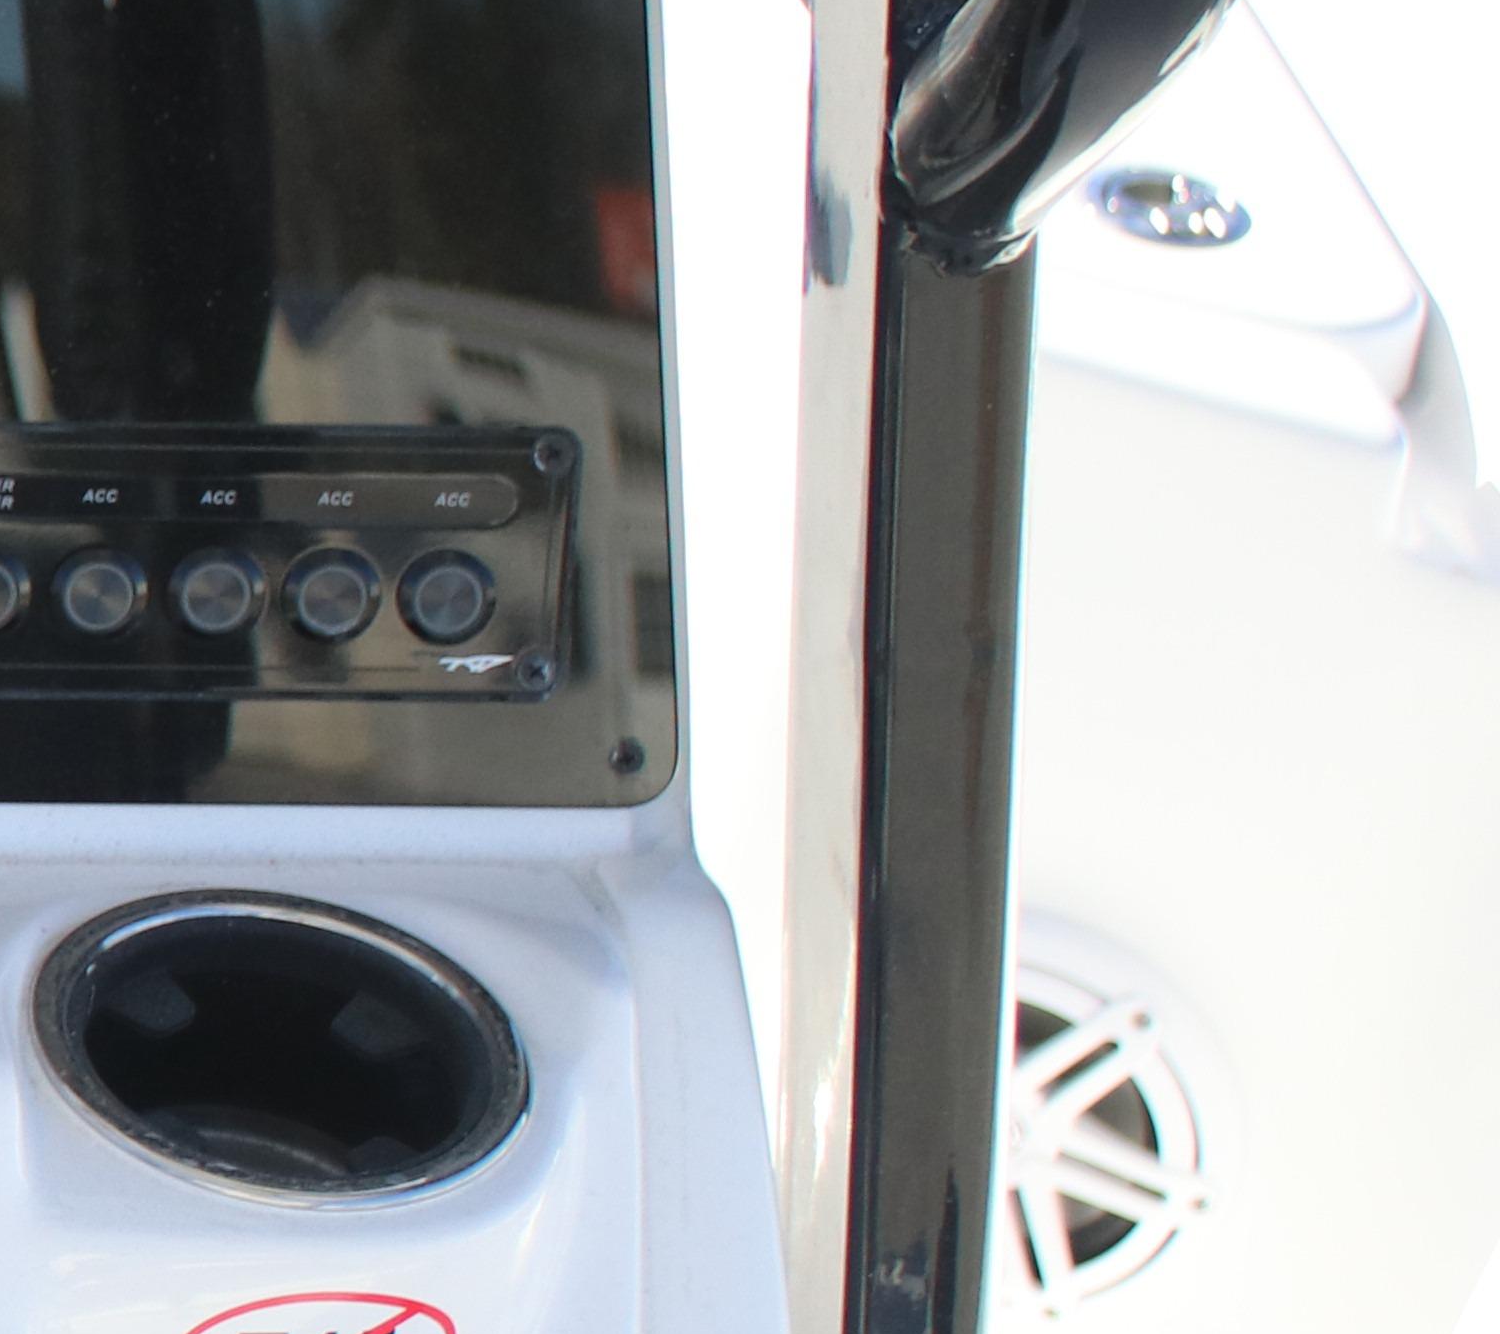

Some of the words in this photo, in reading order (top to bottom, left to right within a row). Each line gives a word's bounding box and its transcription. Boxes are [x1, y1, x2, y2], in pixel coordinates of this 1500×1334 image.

[83, 489, 118, 505] ACC
[200, 489, 237, 506] ACC
[318, 491, 354, 507] ACC
[435, 492, 471, 508] ACC
